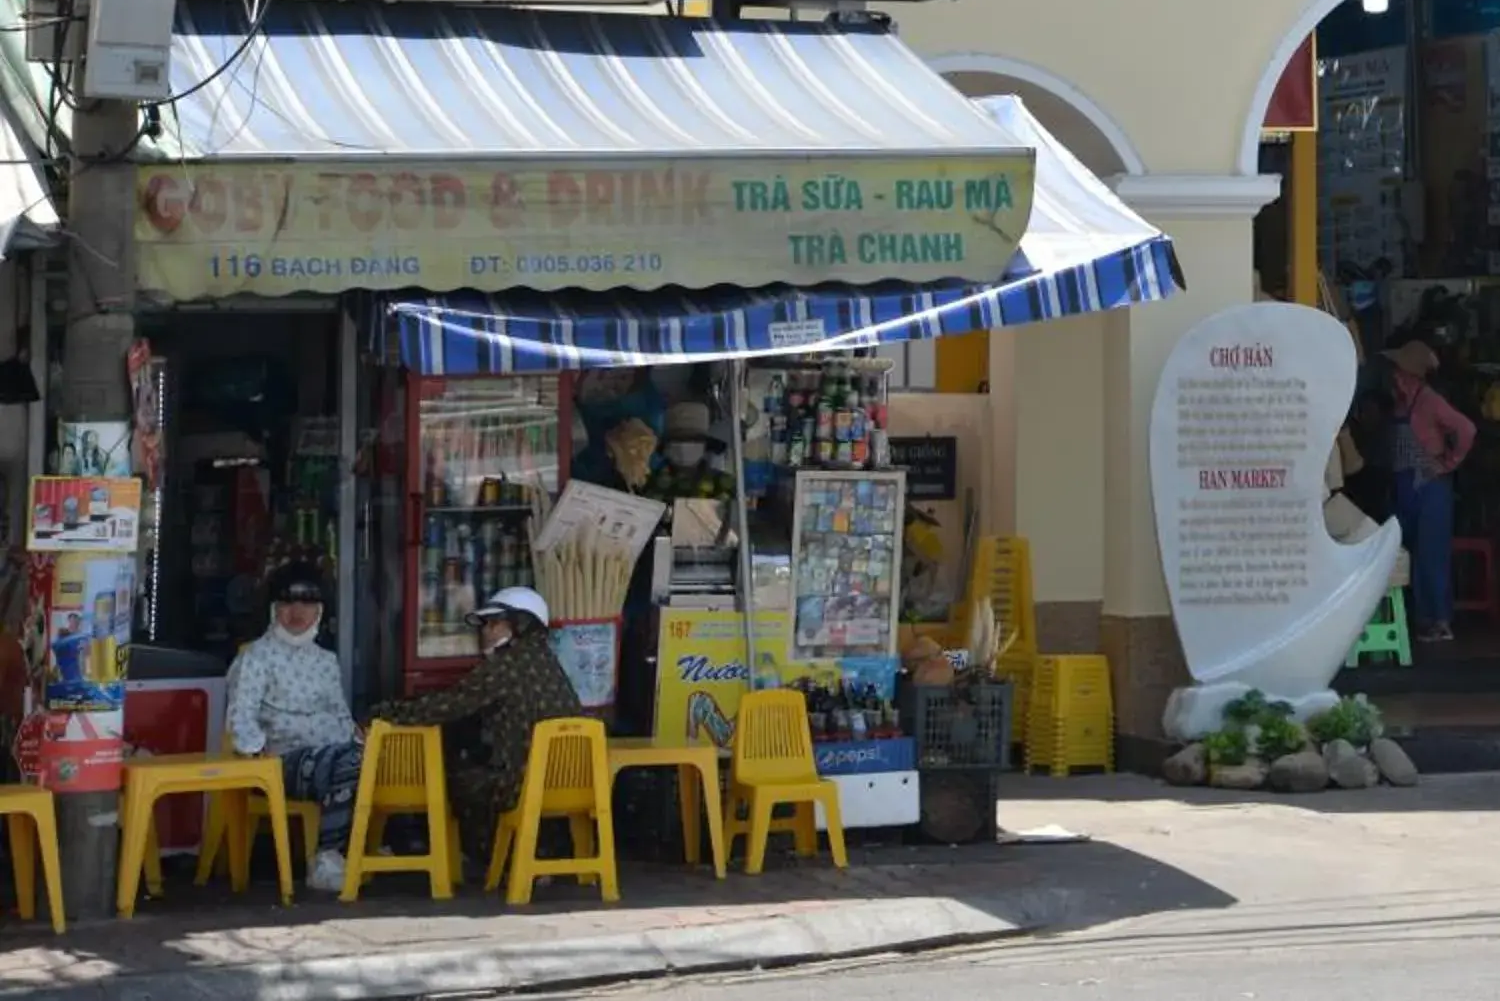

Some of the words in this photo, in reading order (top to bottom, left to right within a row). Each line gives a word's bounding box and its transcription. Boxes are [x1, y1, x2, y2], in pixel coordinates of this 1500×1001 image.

[801, 173, 863, 211] SỮA
[895, 180, 954, 211] RAU
[857, 233, 964, 263] CHANH
[211, 254, 262, 278] 116
[623, 253, 662, 272] 210
